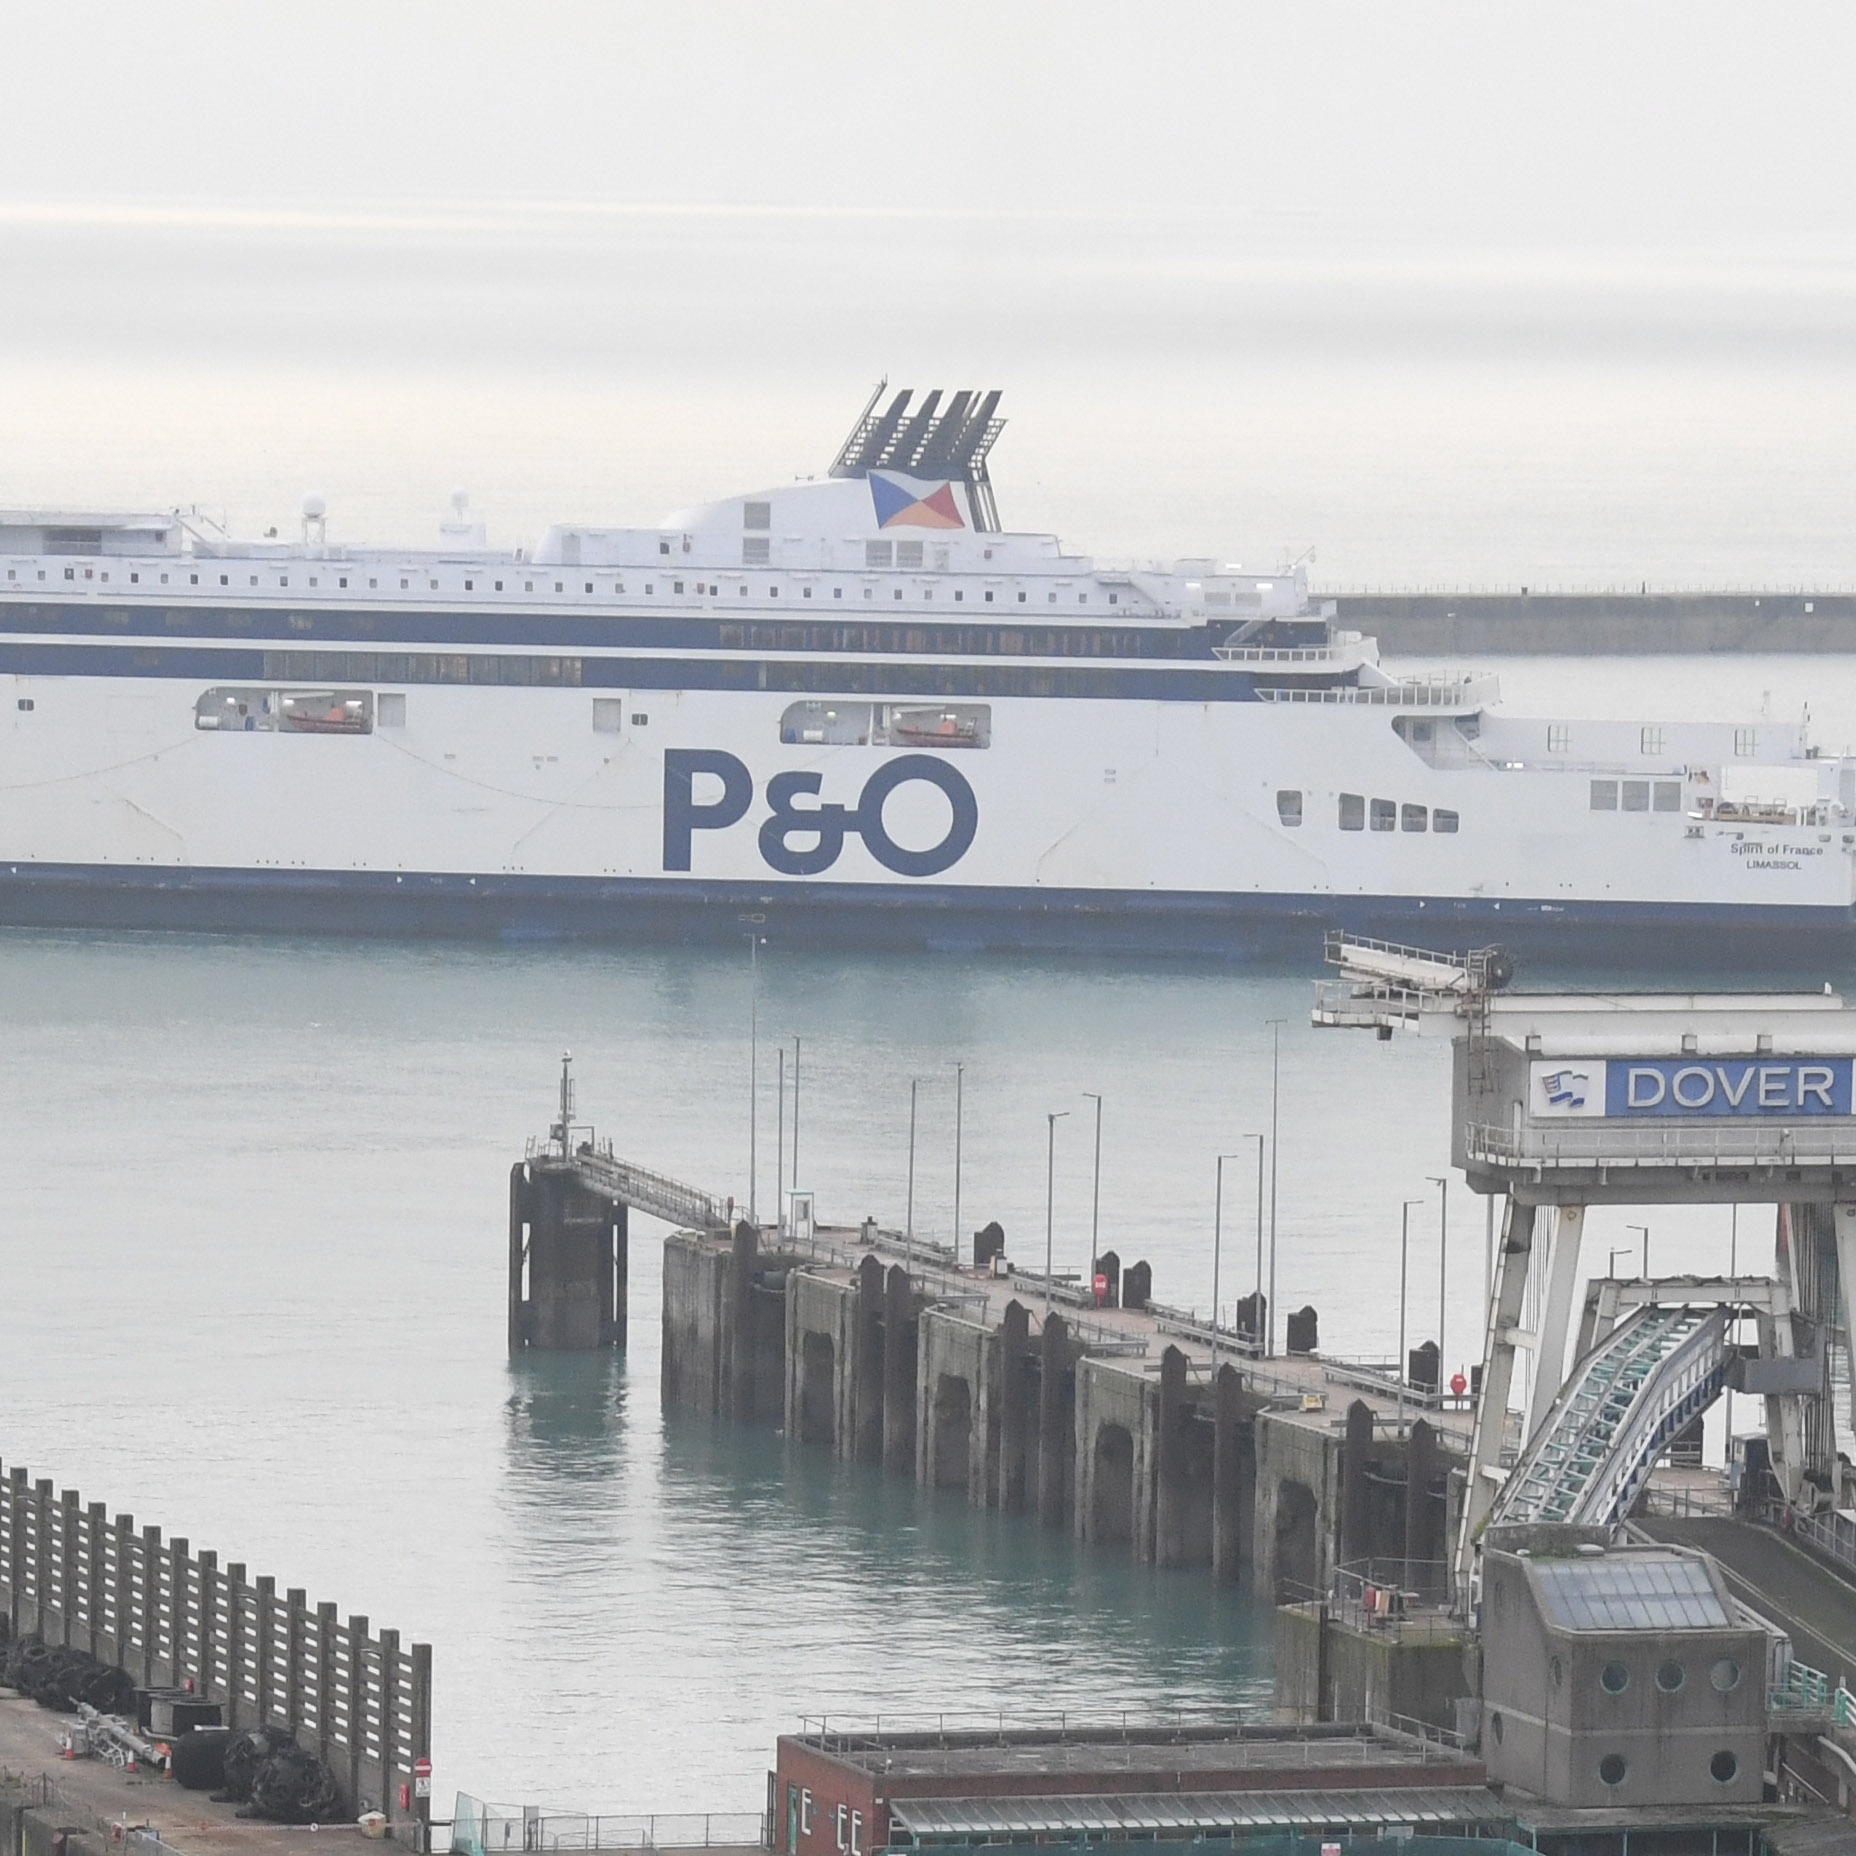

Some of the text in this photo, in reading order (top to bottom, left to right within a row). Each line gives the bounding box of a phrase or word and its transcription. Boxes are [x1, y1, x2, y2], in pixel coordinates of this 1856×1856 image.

[662, 748, 978, 877] P&O
[1731, 842, 1823, 856] Spirit of France
[1746, 860, 1802, 870] LIMASSOL
[1627, 1066, 1835, 1108] DOVER
